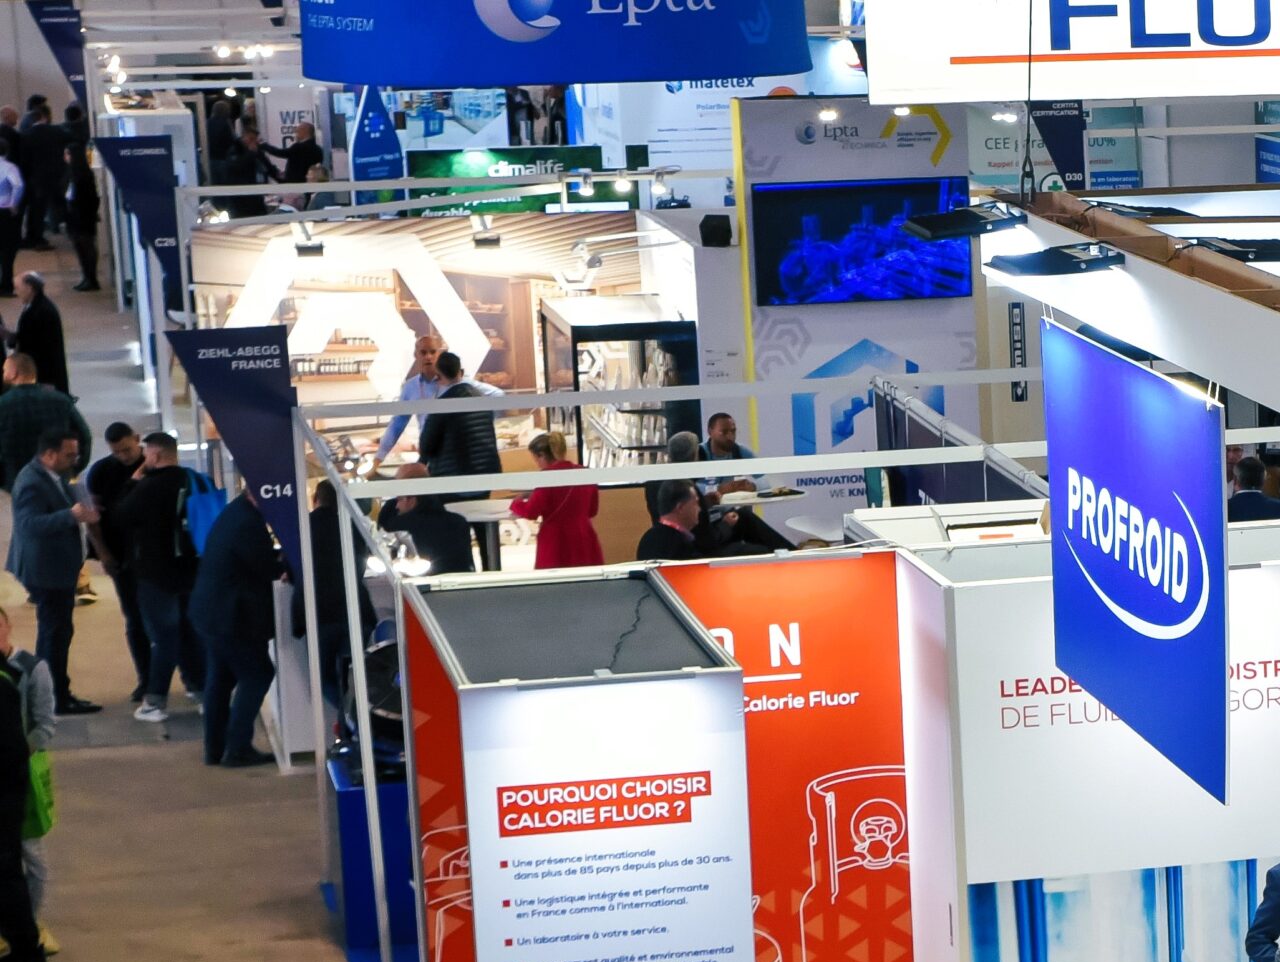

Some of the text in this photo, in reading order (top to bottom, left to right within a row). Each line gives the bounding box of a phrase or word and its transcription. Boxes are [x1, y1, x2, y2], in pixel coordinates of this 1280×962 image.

[336, 16, 374, 31] SYSTEM
[824, 124, 859, 142] Epta
[985, 137, 1010, 150] CEE
[1065, 172, 1083, 181] D30
[198, 345, 280, 359] ZIEHL-ABEGG
[231, 359, 281, 370] FRANCE
[260, 484, 293, 499] C14
[829, 489, 846, 498] WE
[1067, 467, 1189, 604] PROFROID
[744, 690, 860, 712] Calorie Fluor
[1002, 705, 1040, 729] DE
[502, 776, 707, 807] POURQUOI CHOISIR
[503, 801, 686, 830] CALORIE FLUOR ?
[512, 849, 656, 868] Une présence internationale
[514, 854, 733, 880] dans plus de 85 pays depuis plus de 30 ans.
[514, 883, 710, 907] Une logistique intégrée et performante
[516, 897, 689, 919] en France comme à l'international.
[517, 925, 669, 946] Un laboratoire à votre service.
[638, 953, 648, 962] et
[650, 945, 734, 961] environnemental
